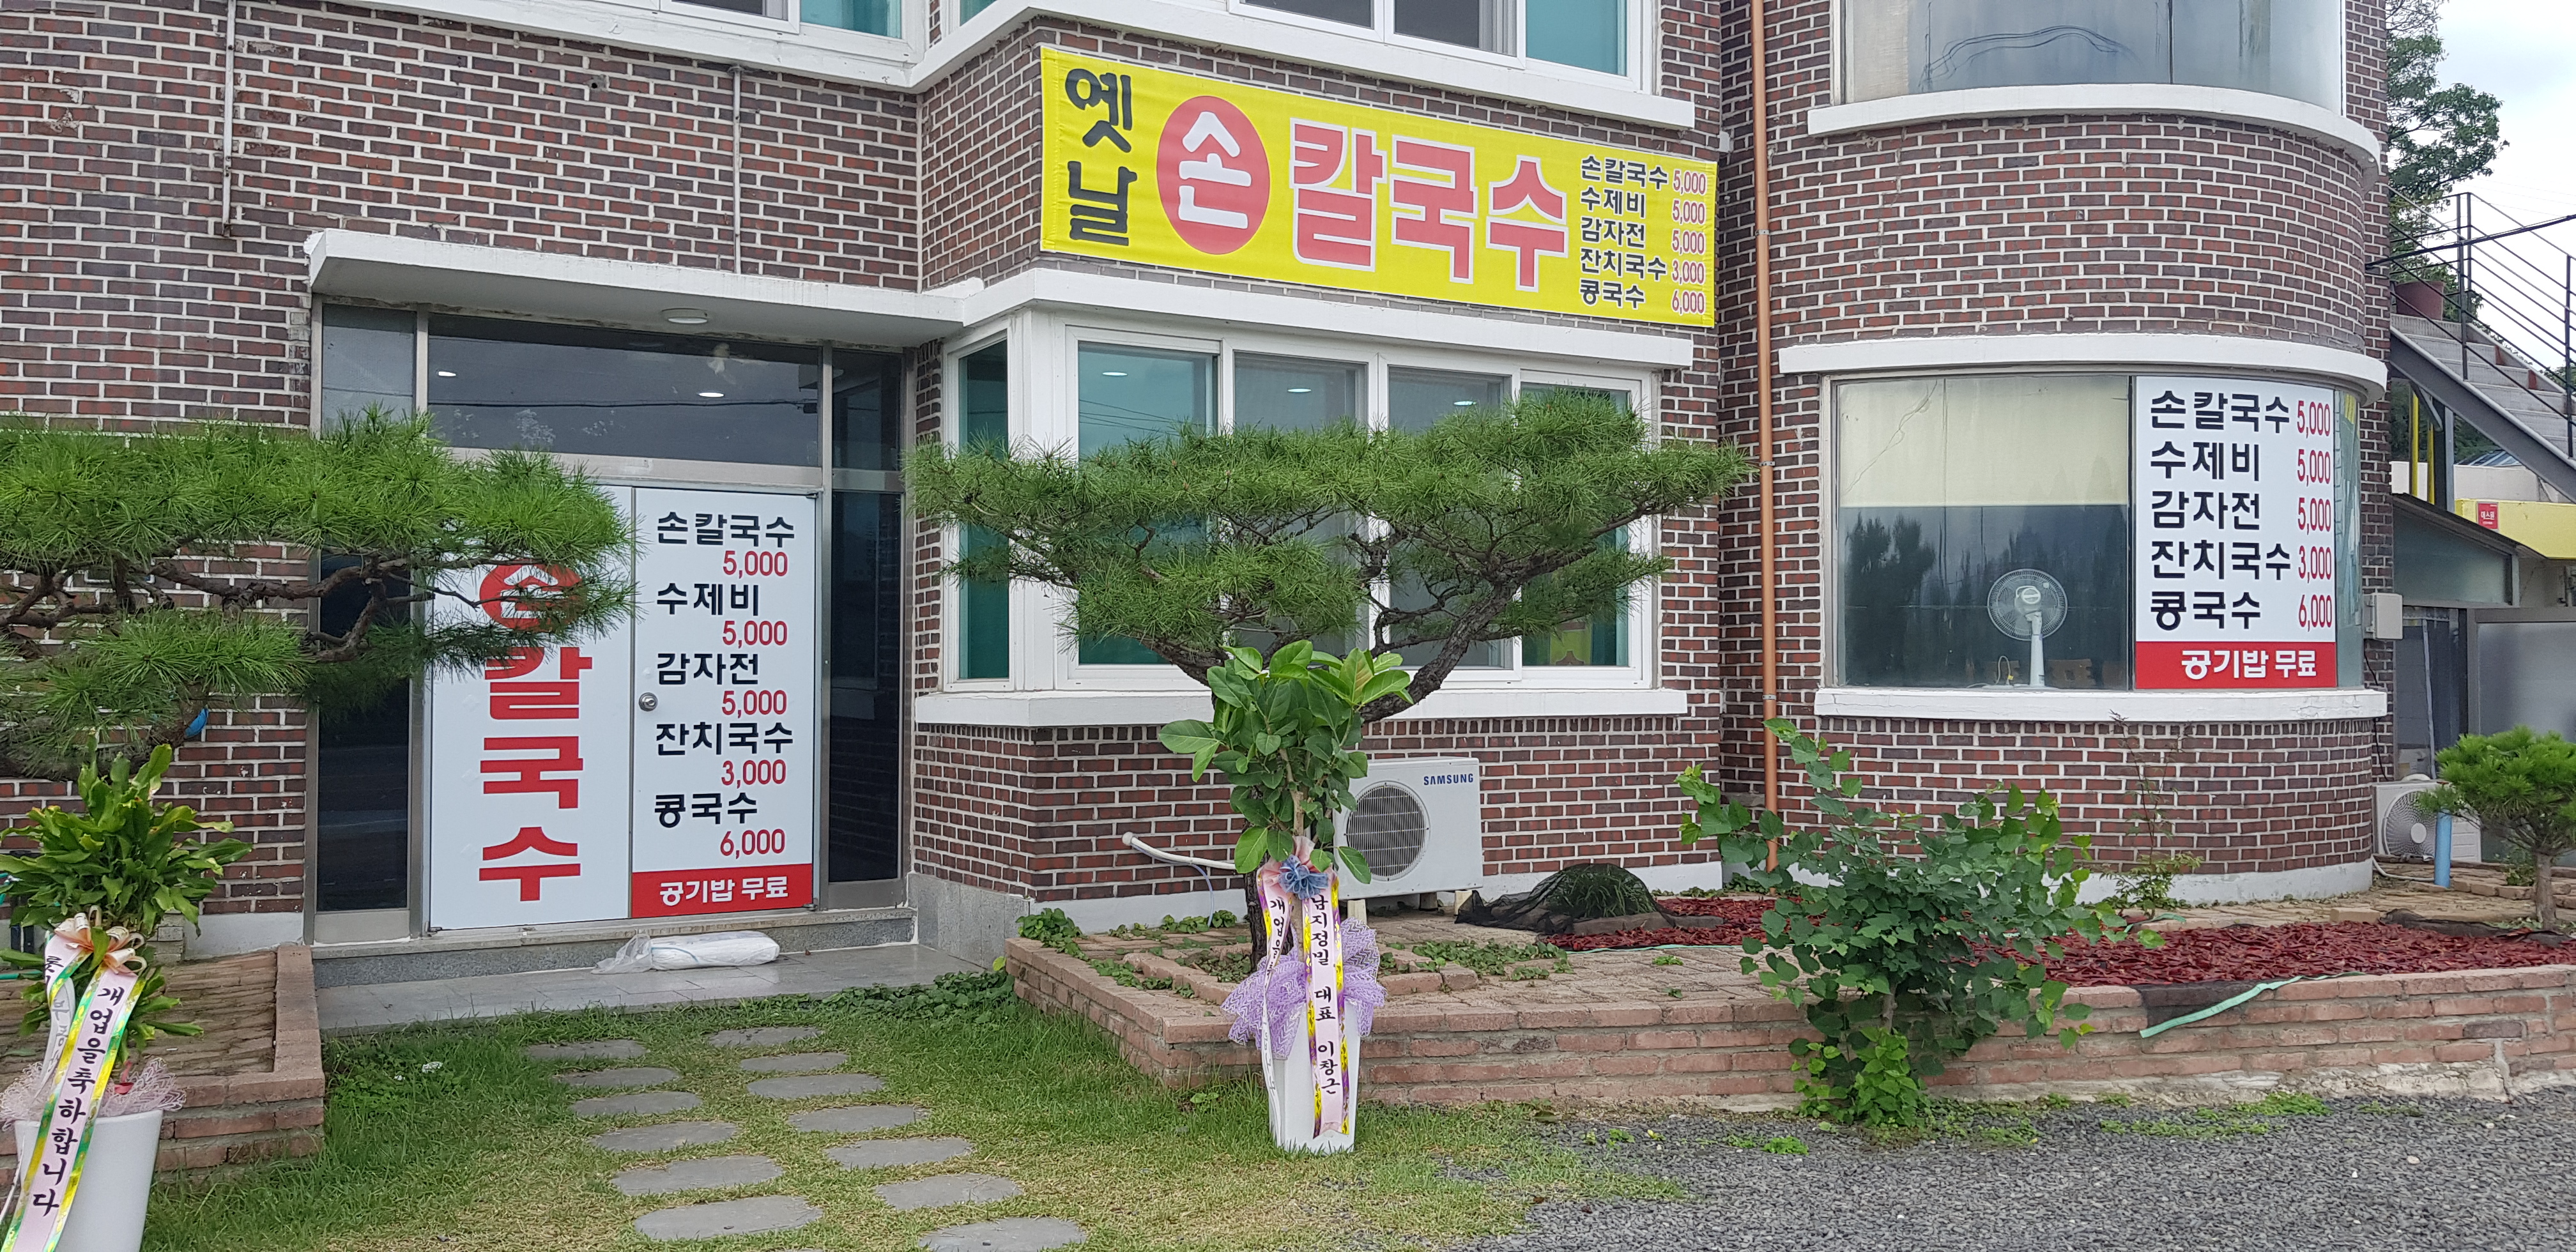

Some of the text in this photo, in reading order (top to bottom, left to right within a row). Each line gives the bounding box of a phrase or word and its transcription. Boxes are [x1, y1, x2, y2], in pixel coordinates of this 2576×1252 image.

[1065, 68, 1137, 247] 옛날
[1581, 155, 1706, 194] 손칼국수 5,000
[1581, 187, 1705, 225] 수제비 5,000
[1581, 217, 1705, 254] 감자전 5,000
[1581, 248, 1705, 284] 잔치국수 3,000
[1580, 279, 1705, 314] 콩국수 6,000
[2151, 391, 2330, 438] 손칼국수 5,000
[2151, 441, 2331, 485] 수제비 5,000
[657, 512, 794, 547] 손칼국수
[2152, 491, 2331, 533] 감자전 5,000
[724, 551, 787, 576] 5,000
[2152, 540, 2332, 581] 잔치국수 3,000
[657, 583, 758, 616] 수제비
[2151, 592, 2333, 630] 콩국수 6,000
[723, 621, 786, 646] 5,000
[657, 653, 758, 685] 감자전
[2182, 651, 2316, 679] 공기밥 무료
[723, 691, 786, 716] 5,000
[657, 722, 793, 756] 잔치국수
[722, 760, 785, 787] 3,000
[1423, 774, 1474, 786] SAMSUNG
[655, 793, 757, 828] 콩국수
[721, 829, 785, 857] 6,000
[661, 877, 787, 905] 공기밥 무료
[1310, 895, 1340, 1094] 남지정밀 대표 이창근
